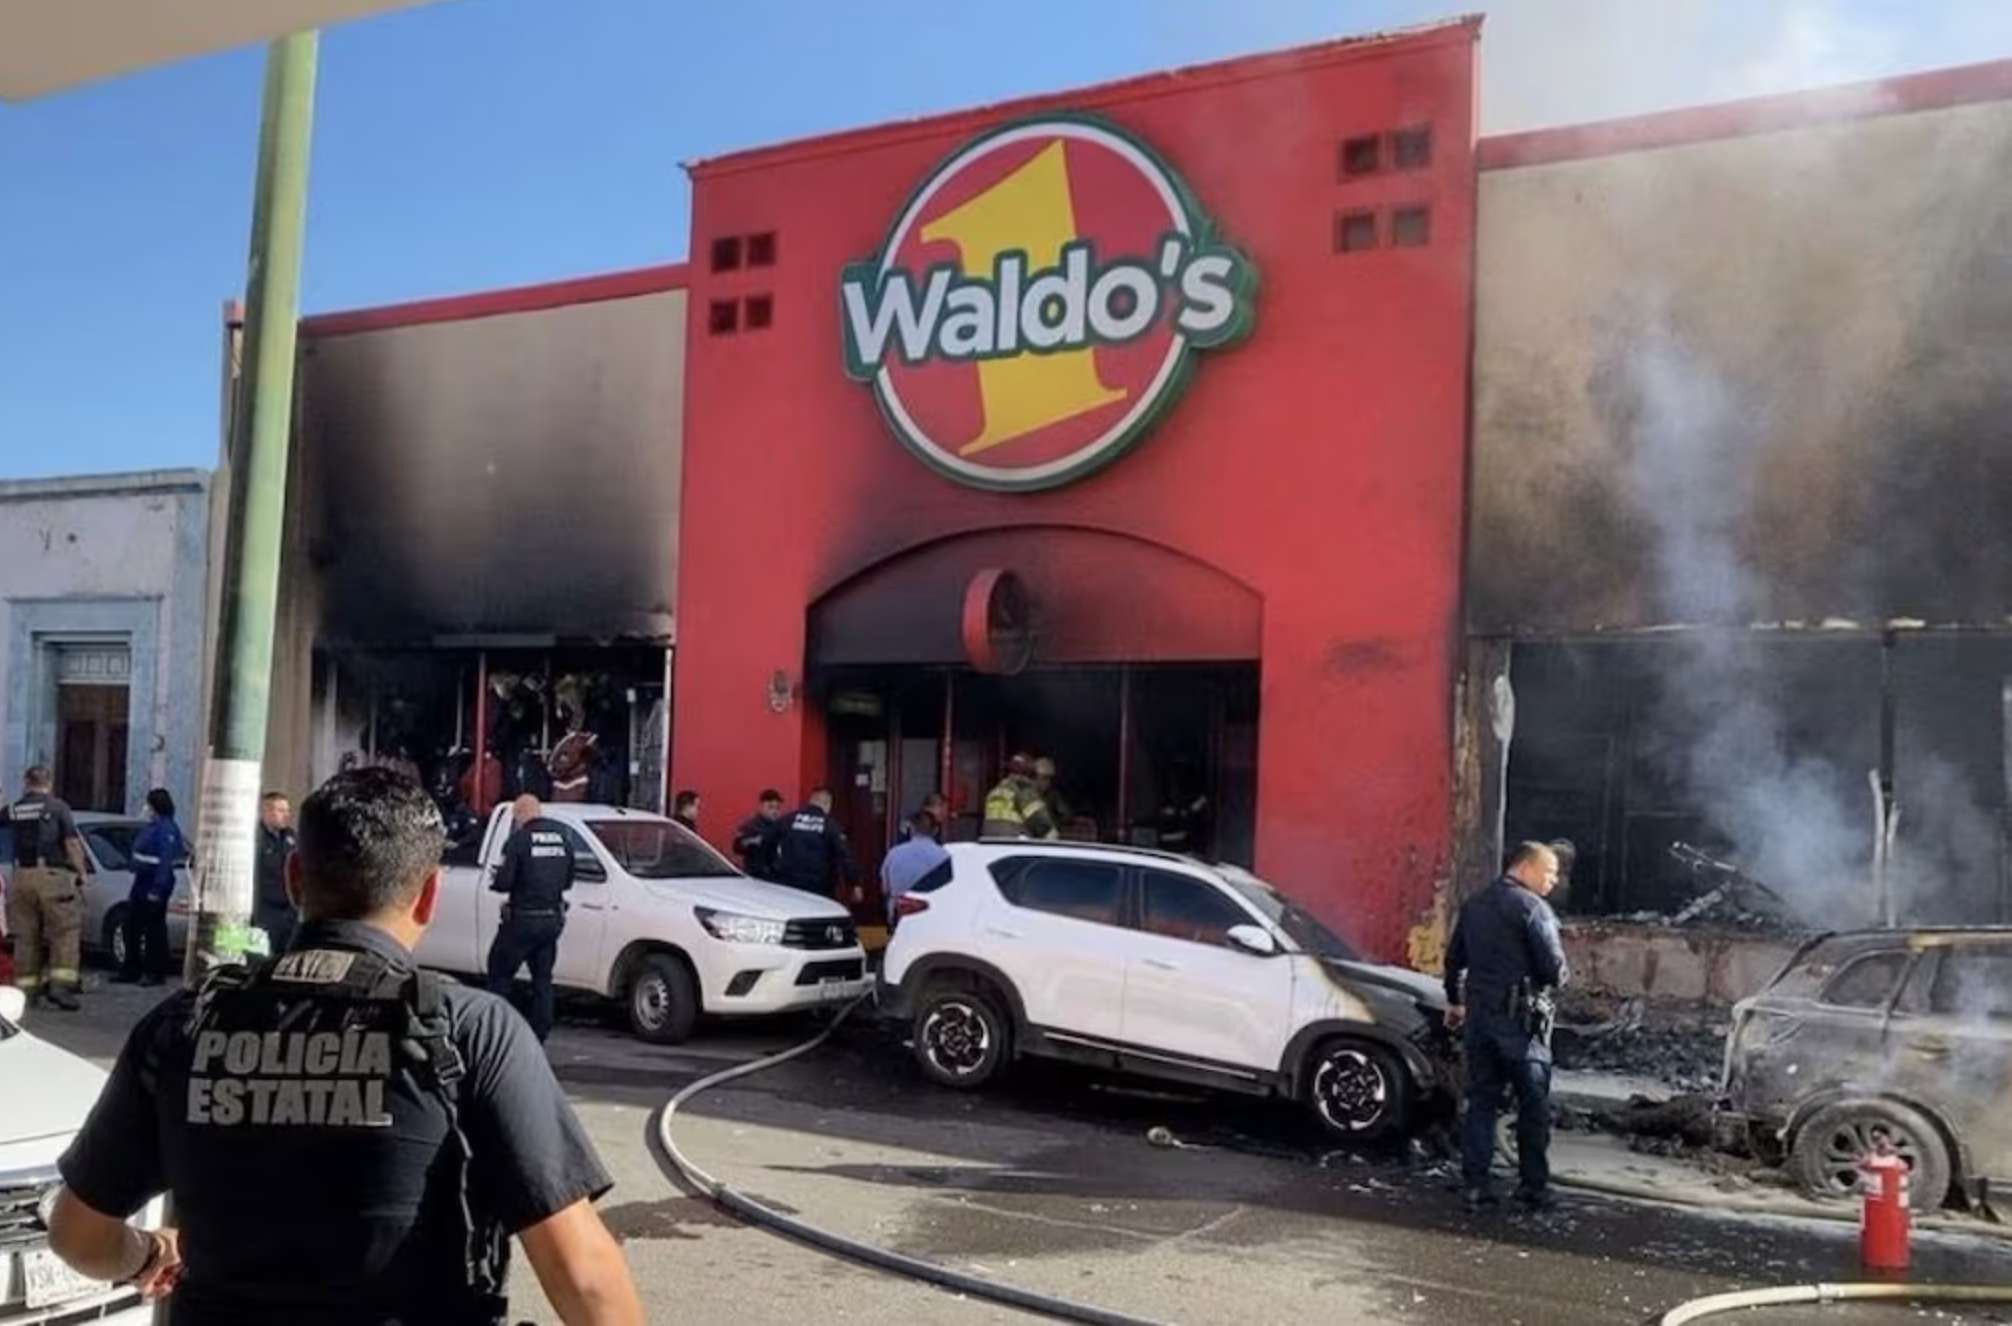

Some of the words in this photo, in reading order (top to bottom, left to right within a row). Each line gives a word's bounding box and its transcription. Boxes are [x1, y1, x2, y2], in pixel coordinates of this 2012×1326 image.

[842, 239, 1235, 366] Waldo's
[190, 1023, 392, 1075] POLICÍA
[186, 1076, 394, 1126] ESTATAL
